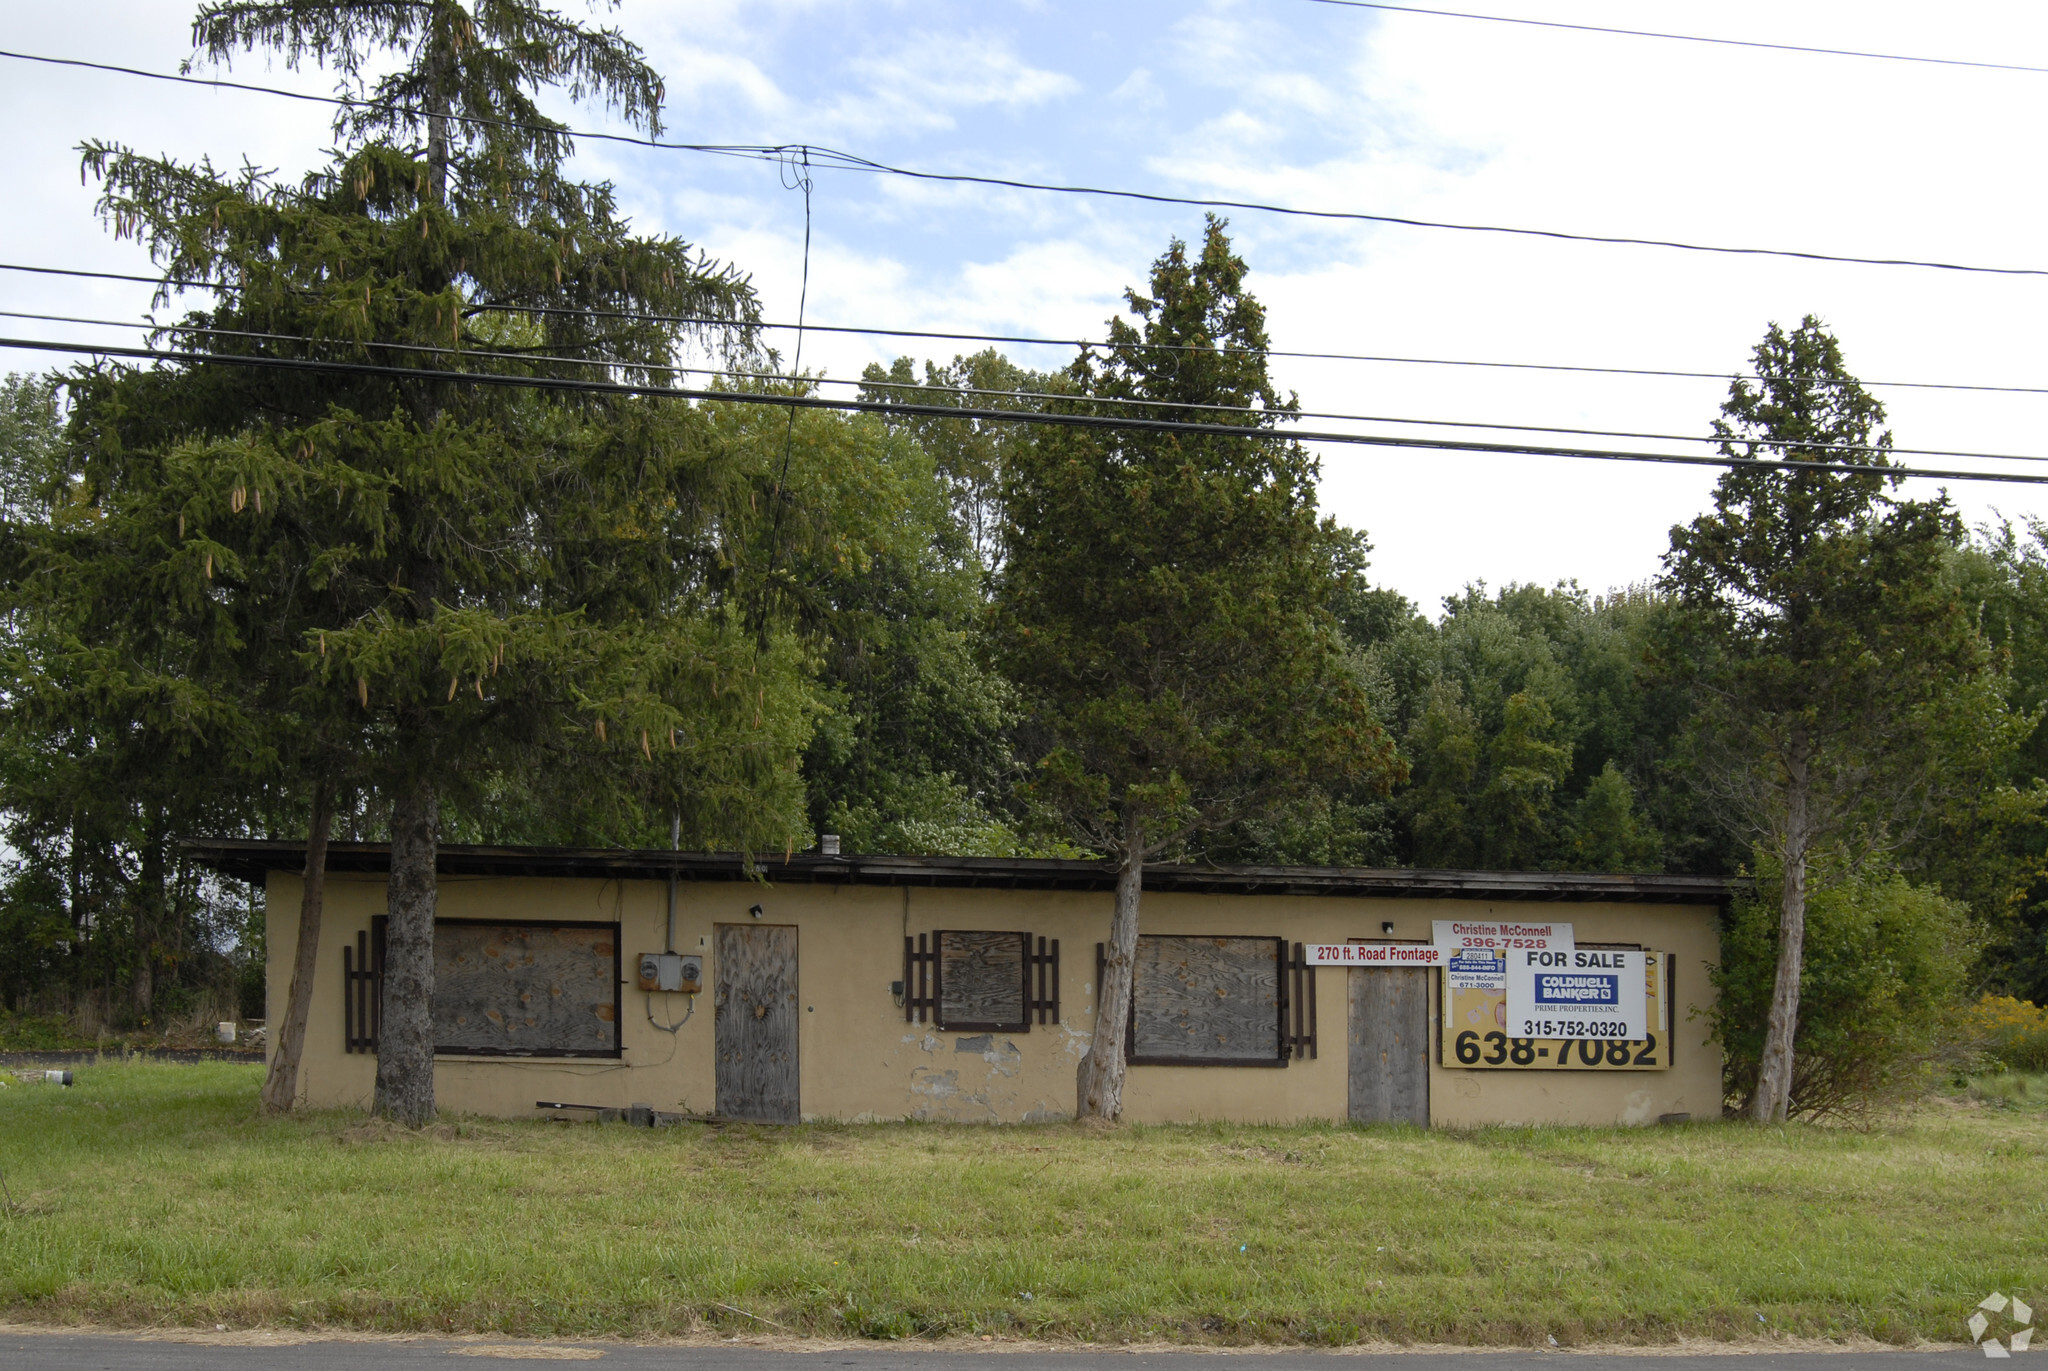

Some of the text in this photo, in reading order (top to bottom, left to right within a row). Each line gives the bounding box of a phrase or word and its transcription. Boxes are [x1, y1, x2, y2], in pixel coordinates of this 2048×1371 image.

[1452, 923, 1552, 937] Christine McConnell
[1462, 937, 1547, 949] 396-7528
[1317, 947, 1439, 963] 270 ft. Road Frontage
[1527, 951, 1625, 969] FOR SALE
[1542, 976, 1612, 988] COLDWELL
[1543, 988, 1599, 1001] BANKER
[1524, 1020, 1627, 1037] 315-752-0320
[1455, 1030, 1657, 1066] 638-7082
